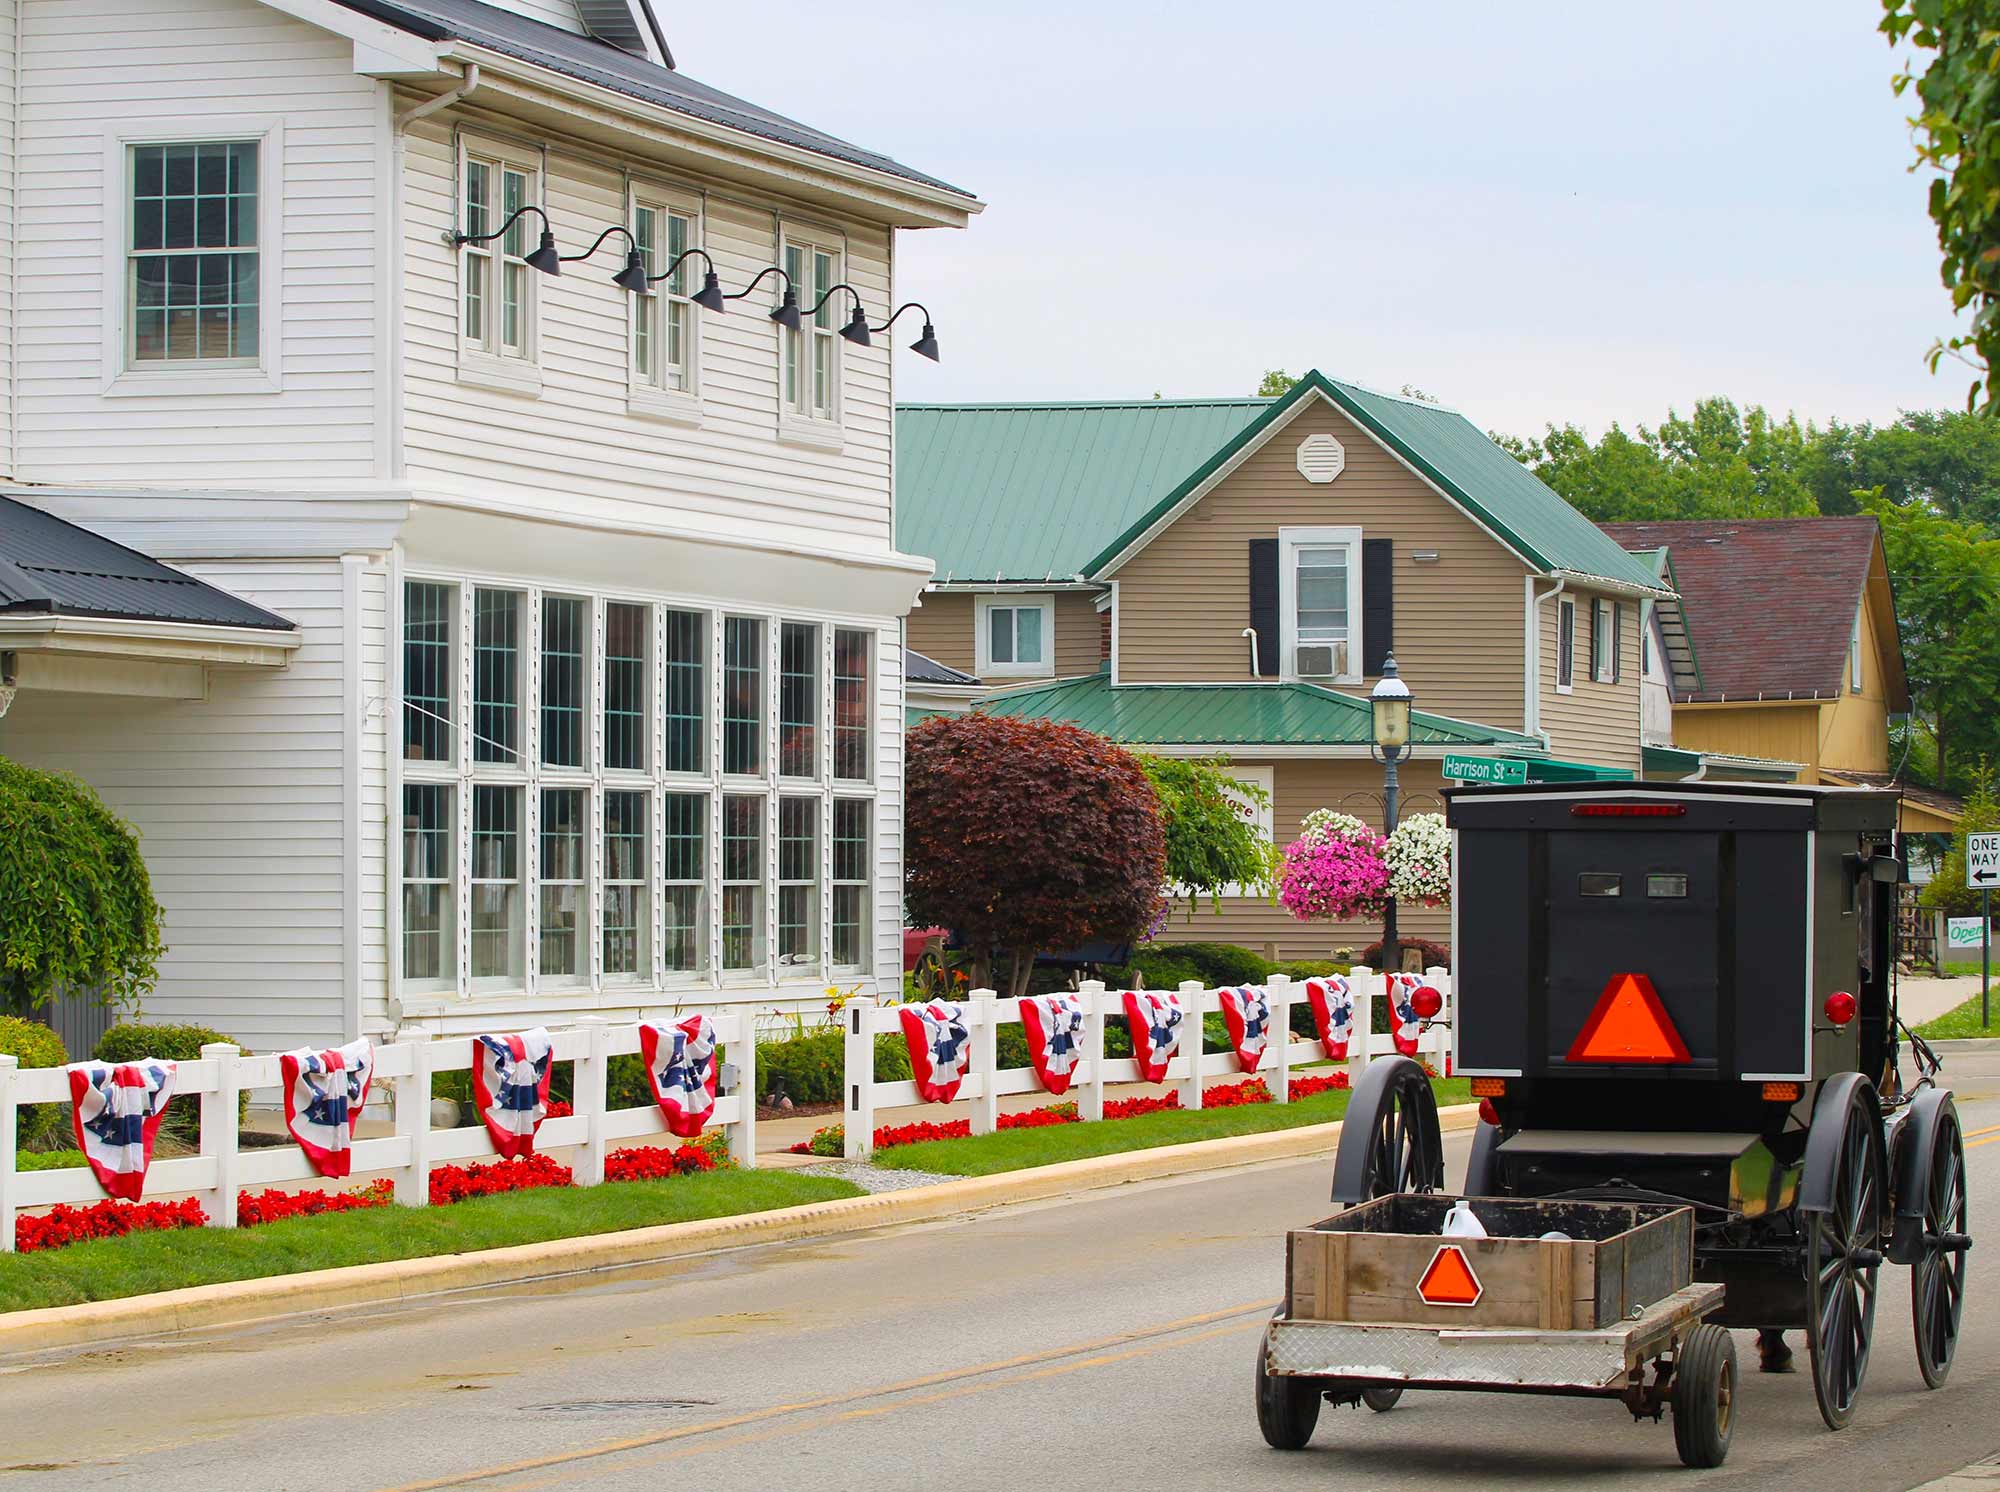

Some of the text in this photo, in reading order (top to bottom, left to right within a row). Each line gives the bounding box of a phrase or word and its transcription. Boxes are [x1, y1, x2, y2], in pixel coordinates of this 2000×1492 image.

[1445, 757, 1505, 780] Harrison St
[1971, 838, 1998, 851] ONE
[1971, 853, 1998, 865] WAY
[1951, 926, 1983, 941] Open
